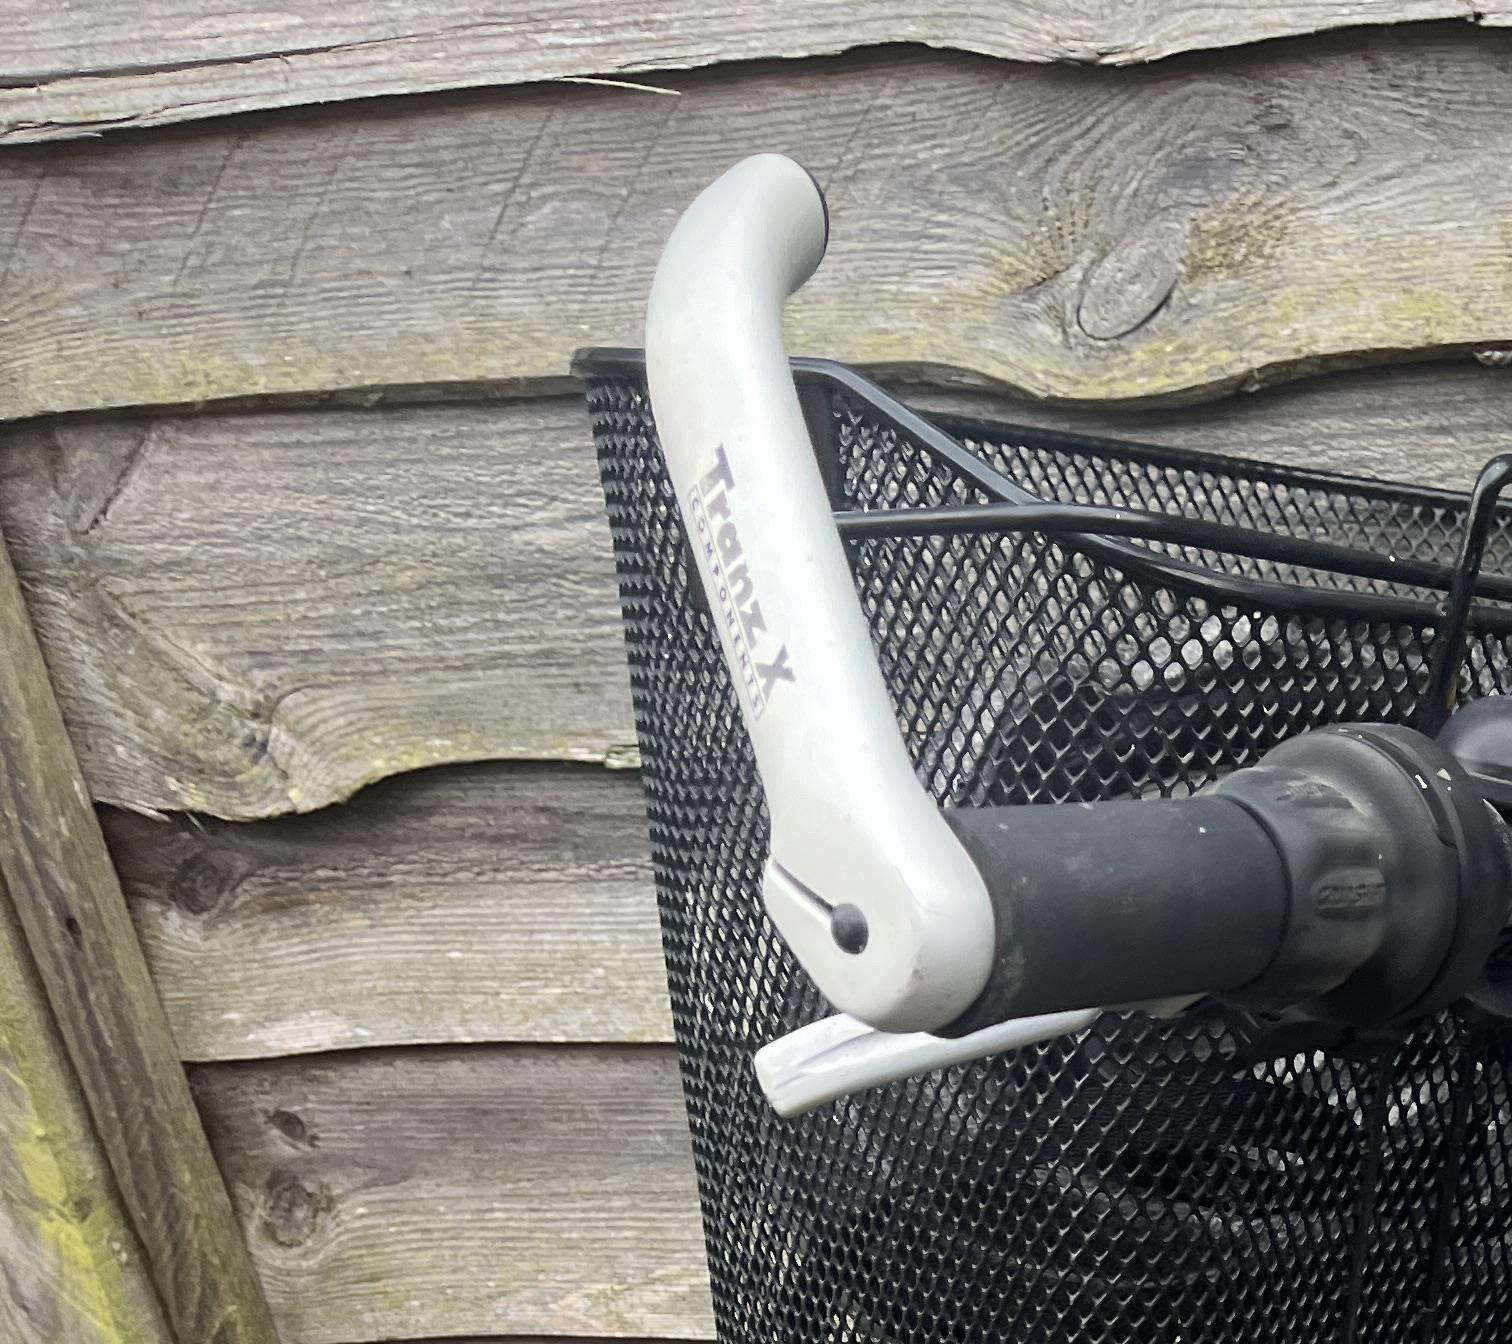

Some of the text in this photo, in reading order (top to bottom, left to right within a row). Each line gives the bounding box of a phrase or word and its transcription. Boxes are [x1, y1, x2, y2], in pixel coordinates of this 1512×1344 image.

[691, 497, 761, 710] COMPONENTS
[699, 443, 797, 699] Tranz X
